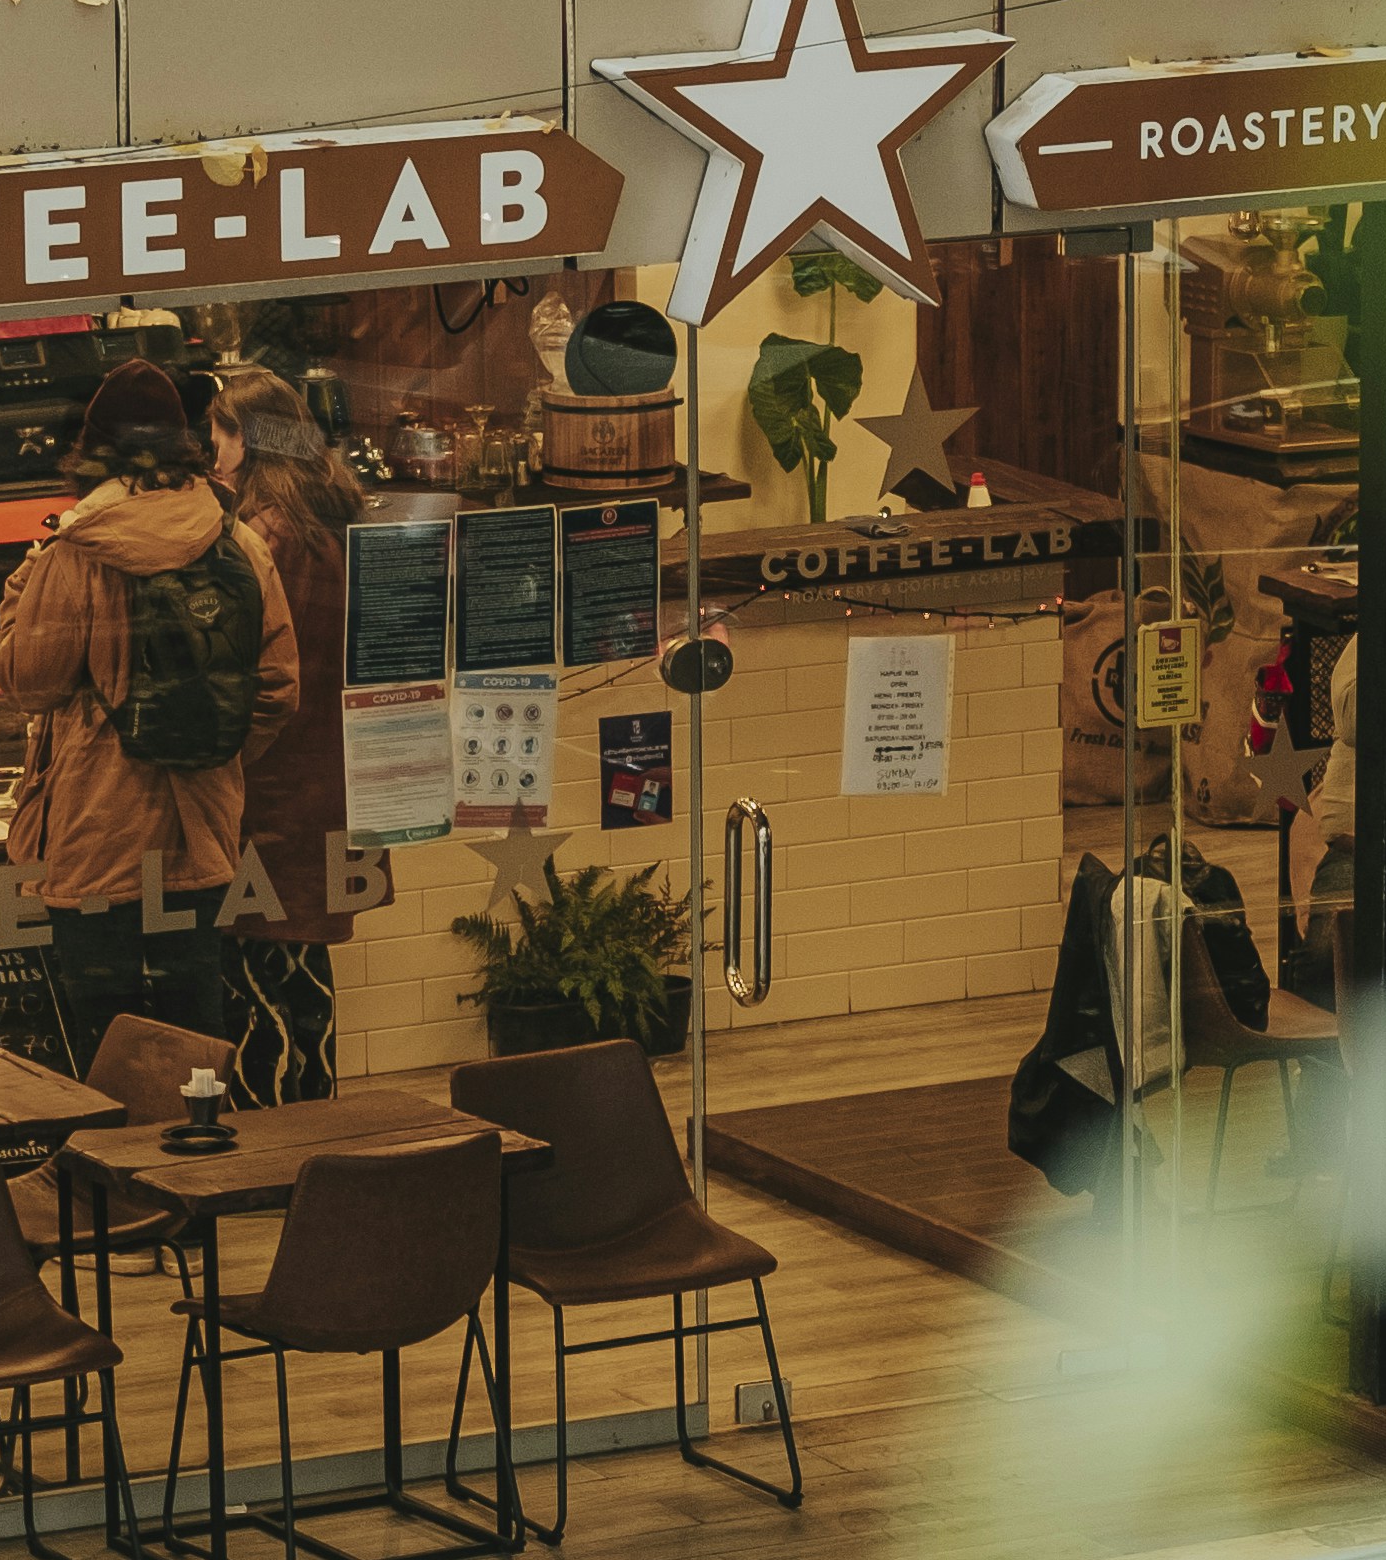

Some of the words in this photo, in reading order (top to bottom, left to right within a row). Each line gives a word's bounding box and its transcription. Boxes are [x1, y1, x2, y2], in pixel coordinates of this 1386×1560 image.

[760, 526, 1073, 582] COFFEE-LAB
[482, 676, 531, 687] COVID-19
[372, 690, 421, 705] COVID-19
